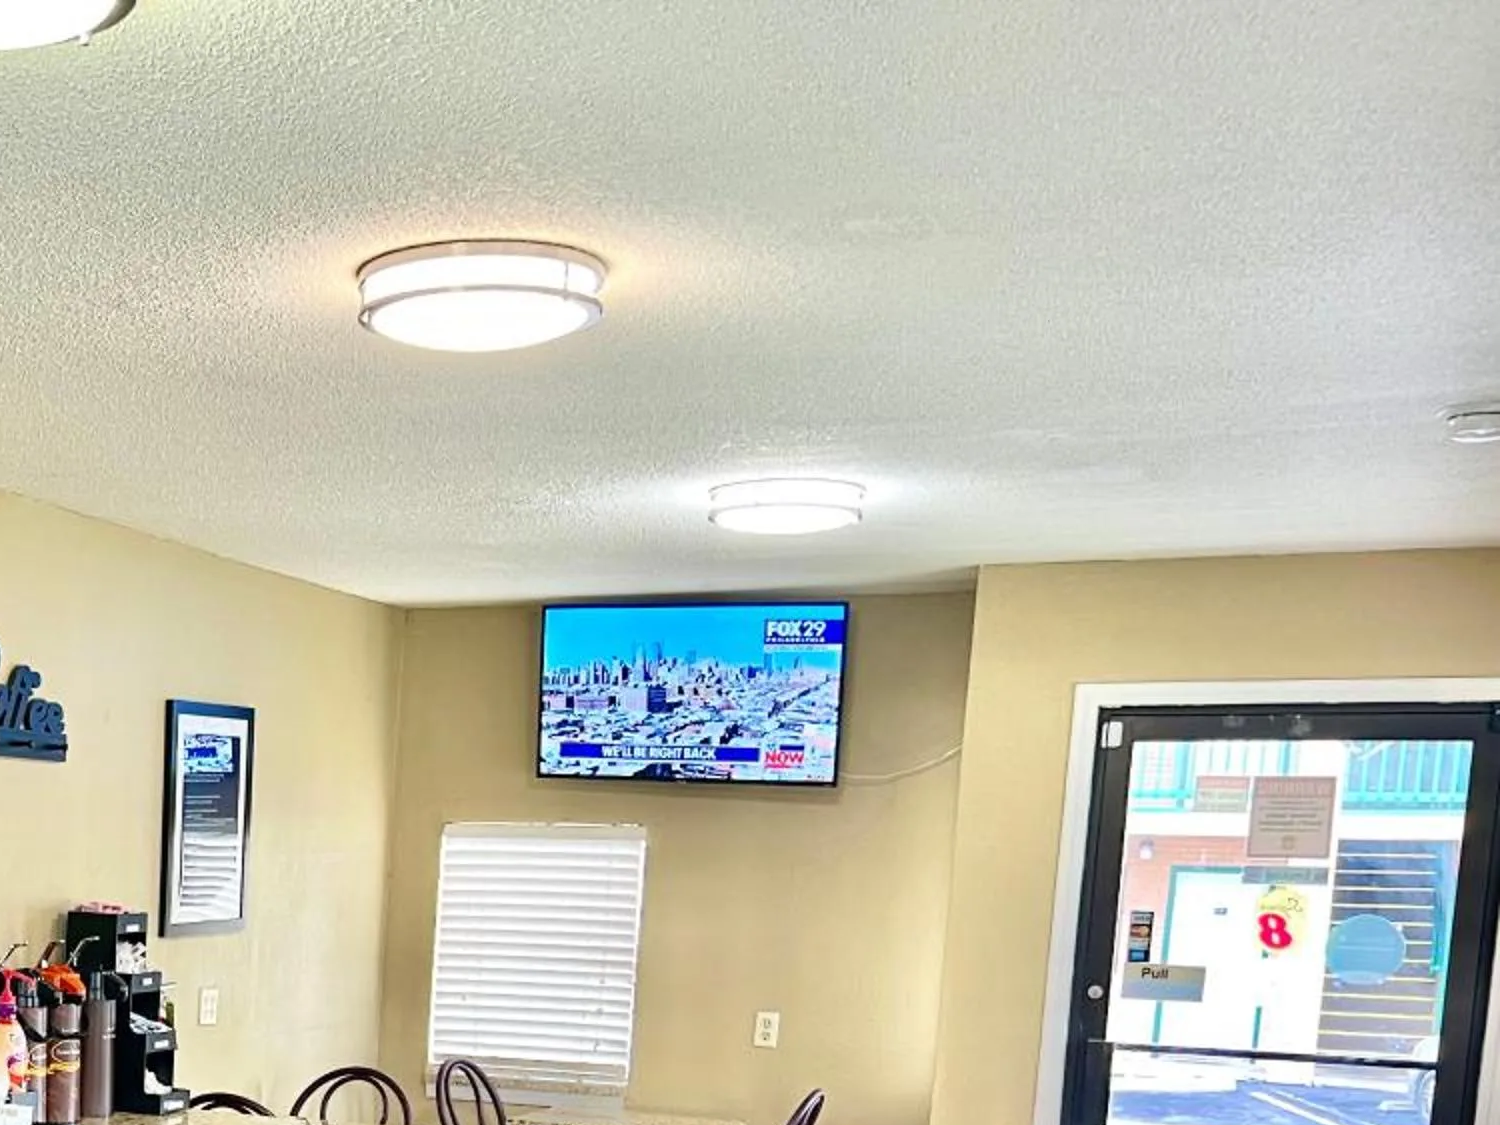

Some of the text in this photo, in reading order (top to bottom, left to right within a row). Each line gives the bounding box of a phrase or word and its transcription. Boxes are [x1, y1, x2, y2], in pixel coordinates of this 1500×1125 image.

[767, 620, 827, 637] FOX 29
[683, 747, 716, 759] BACK
[765, 750, 805, 763] NOW
[1141, 967, 1169, 979] Pull
